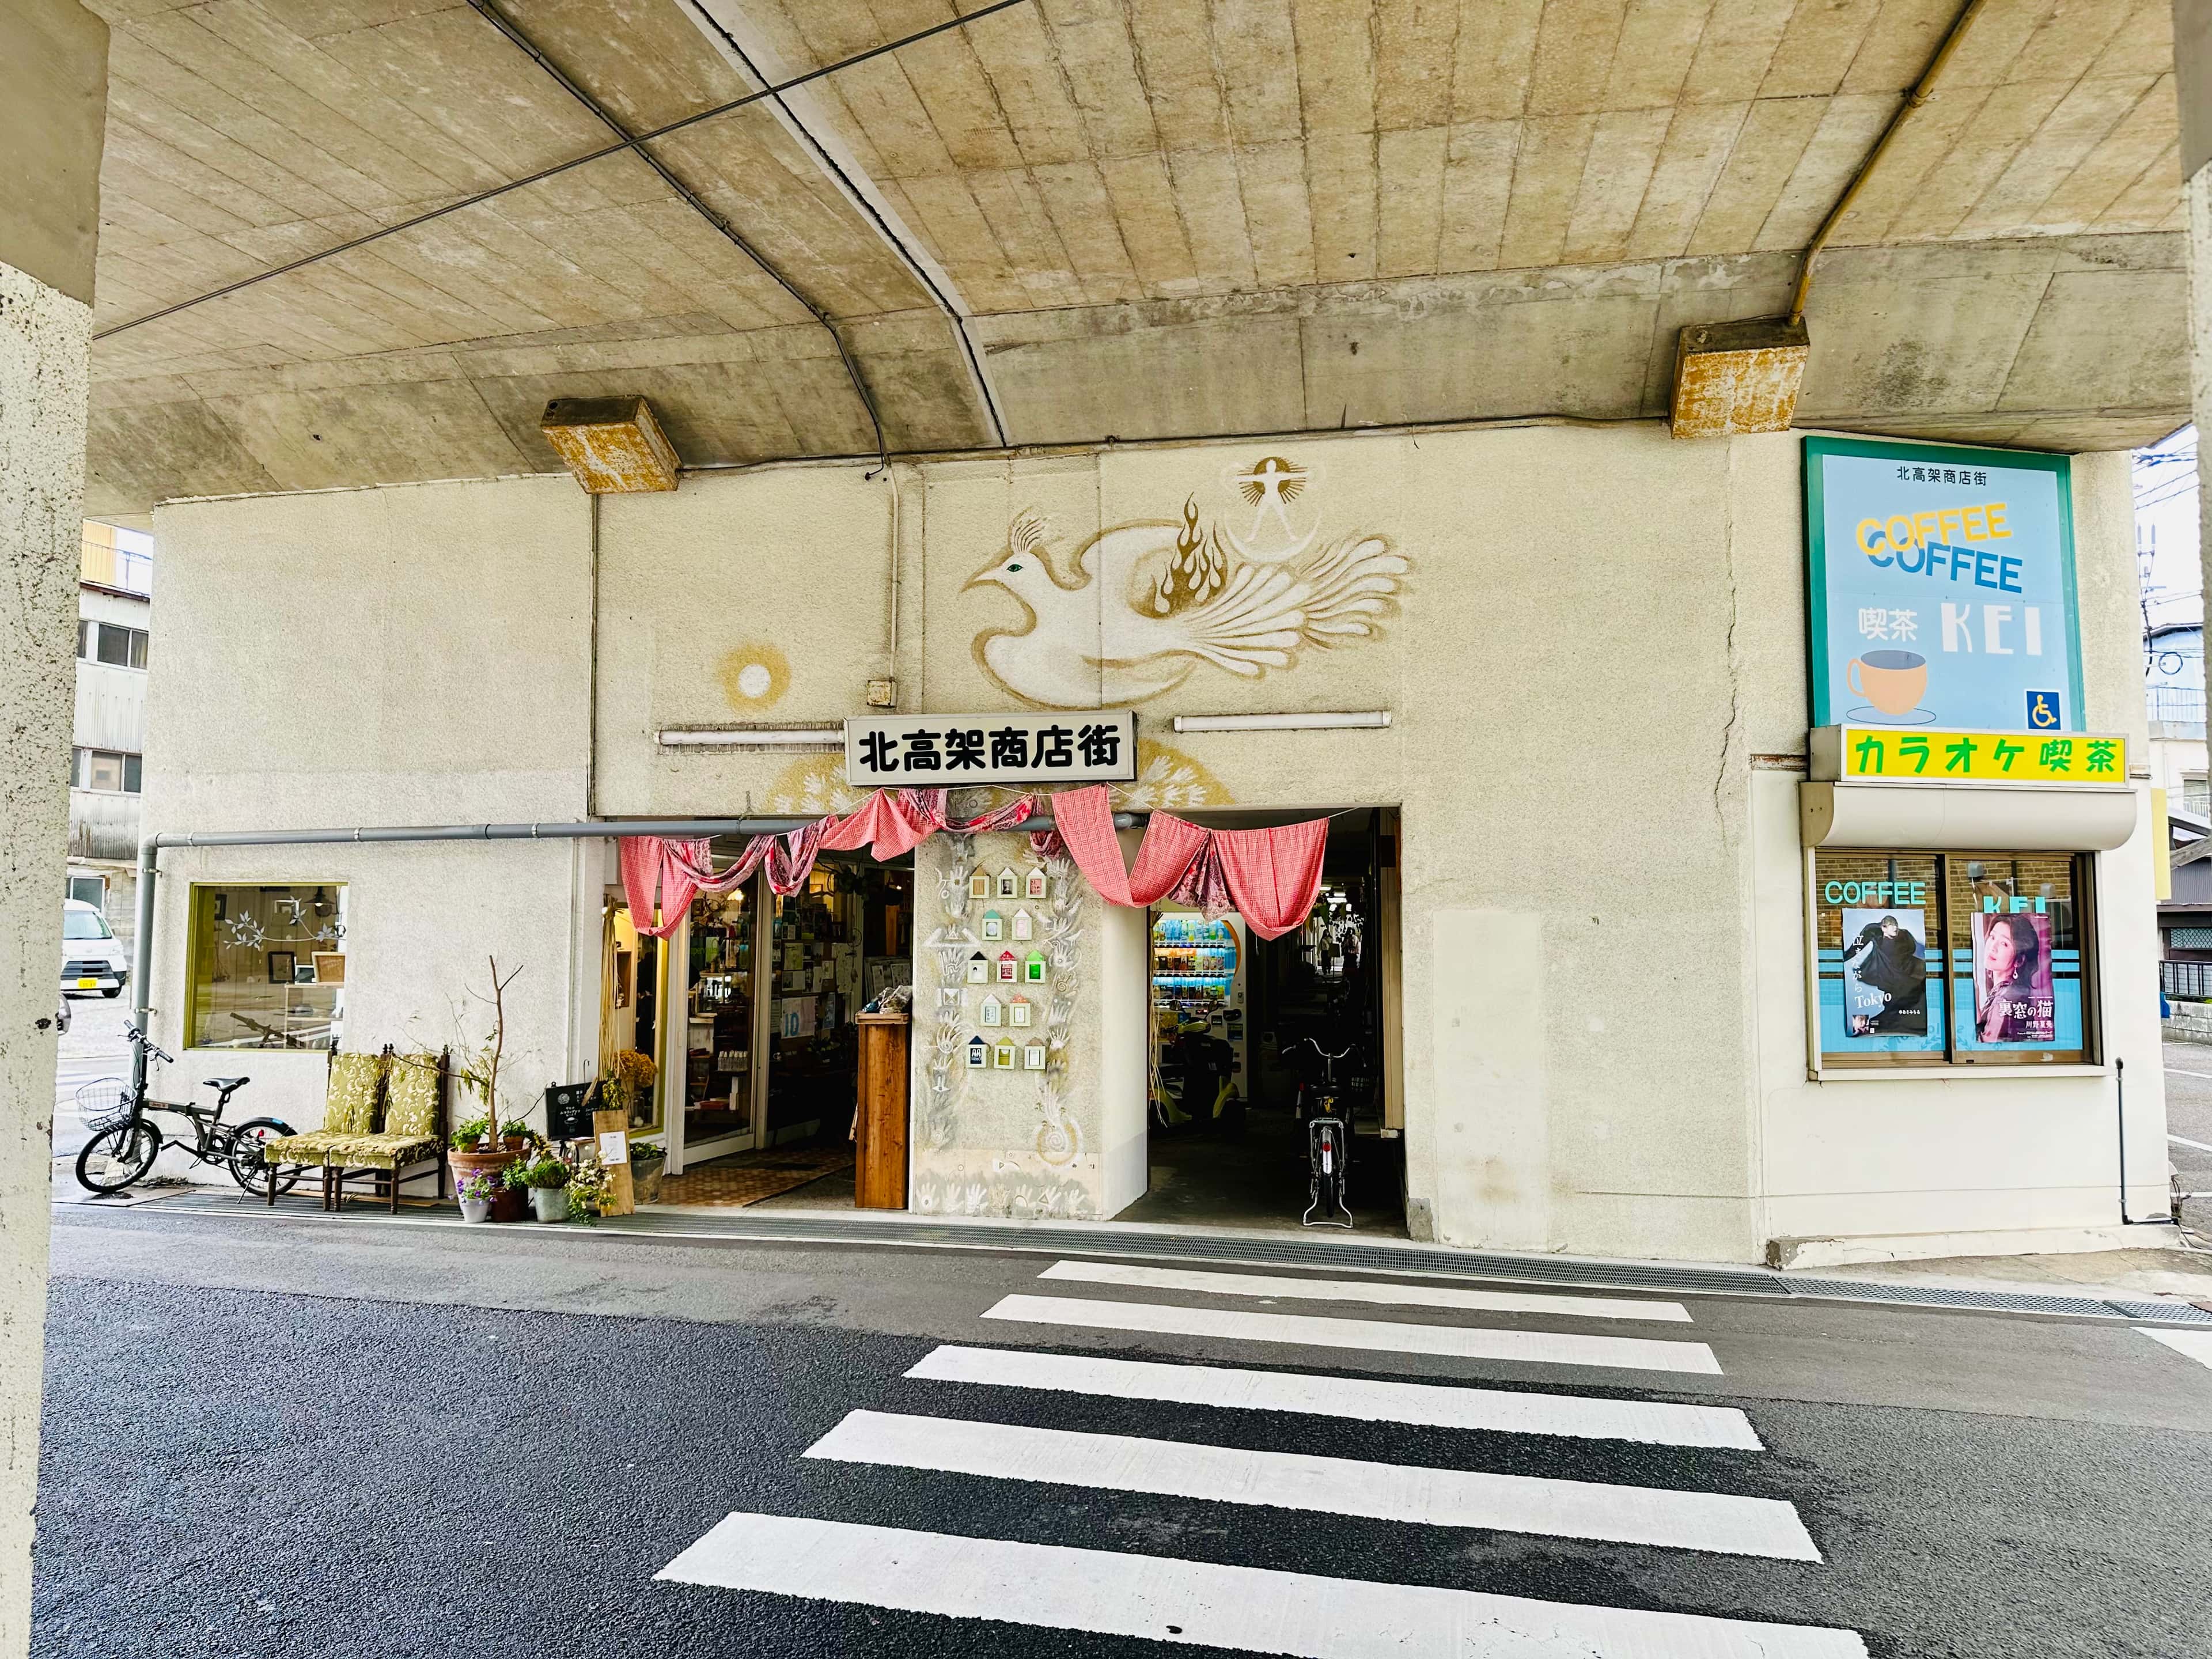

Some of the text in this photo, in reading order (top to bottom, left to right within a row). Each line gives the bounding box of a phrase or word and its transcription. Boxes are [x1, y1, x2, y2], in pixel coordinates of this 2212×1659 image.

[1896, 466, 1987, 486] 北高架商店街
[1856, 503, 2012, 556] COFFEE
[1867, 531, 2022, 594] COFFEE
[1858, 603, 2042, 656] 喫茶 KEI
[859, 724, 1120, 772] 北高架商店街
[1855, 735, 2116, 774] カラオケ喫茶
[1825, 881, 1926, 904] COFFEE
[1855, 993, 1892, 1009] Tokyo
[1998, 999, 2054, 1019] 裏窓の猫
